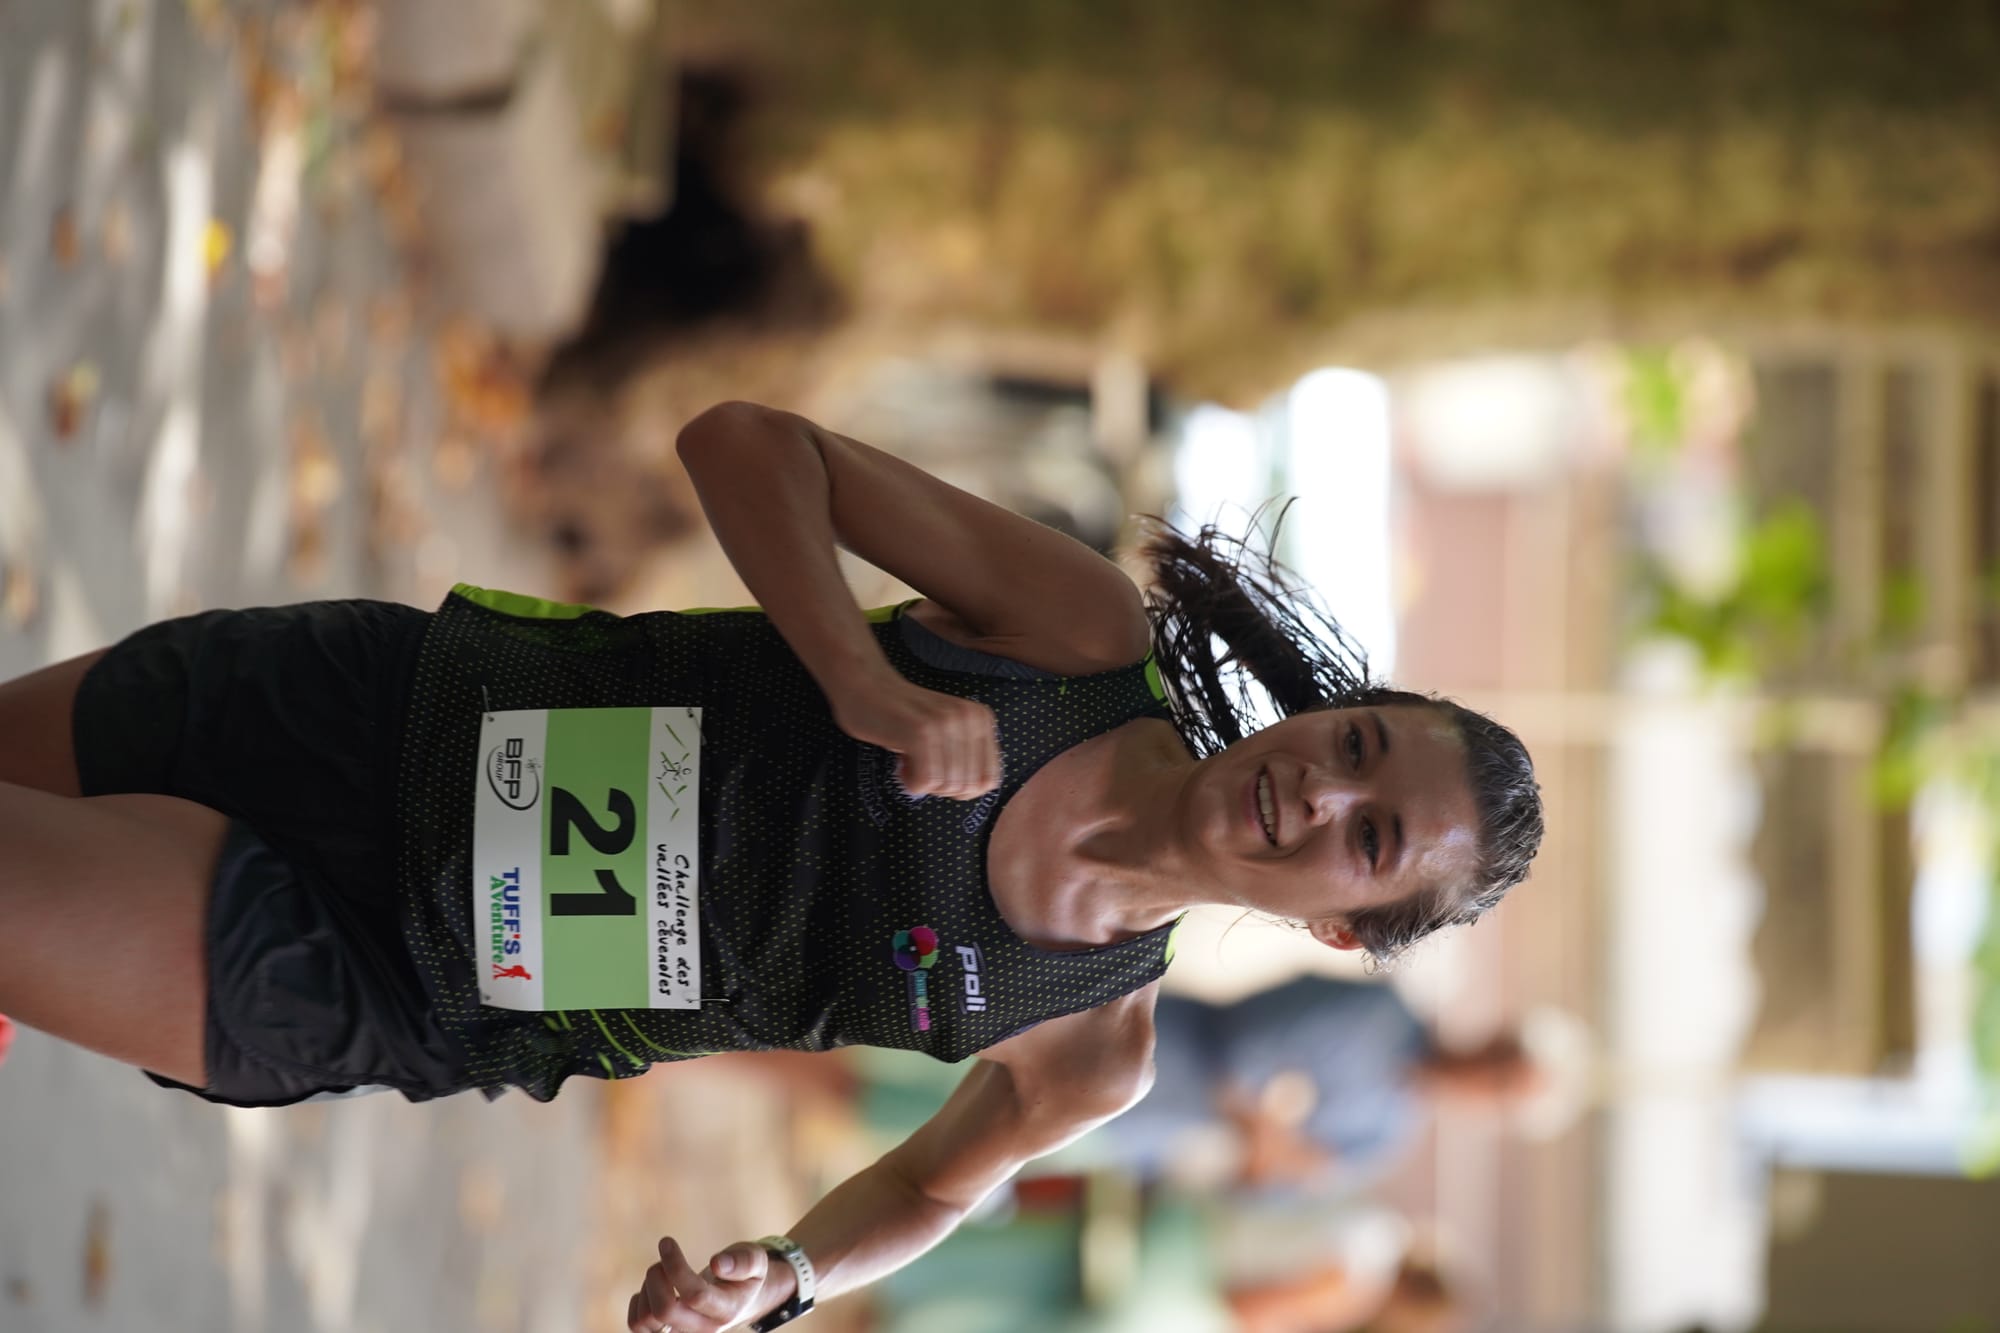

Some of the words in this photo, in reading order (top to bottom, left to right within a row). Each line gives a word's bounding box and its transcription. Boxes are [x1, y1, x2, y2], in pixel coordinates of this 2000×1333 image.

[494, 751, 505, 783] GROUP
[503, 738, 524, 800] BFP
[549, 786, 637, 917] 21
[656, 844, 673, 909] vallées
[490, 875, 506, 964] Aventure
[503, 867, 521, 956] TUFF'S
[671, 854, 690, 946] Challenge
[657, 920, 674, 996] cévenoles
[677, 957, 690, 987] des
[955, 945, 986, 1012] poli
